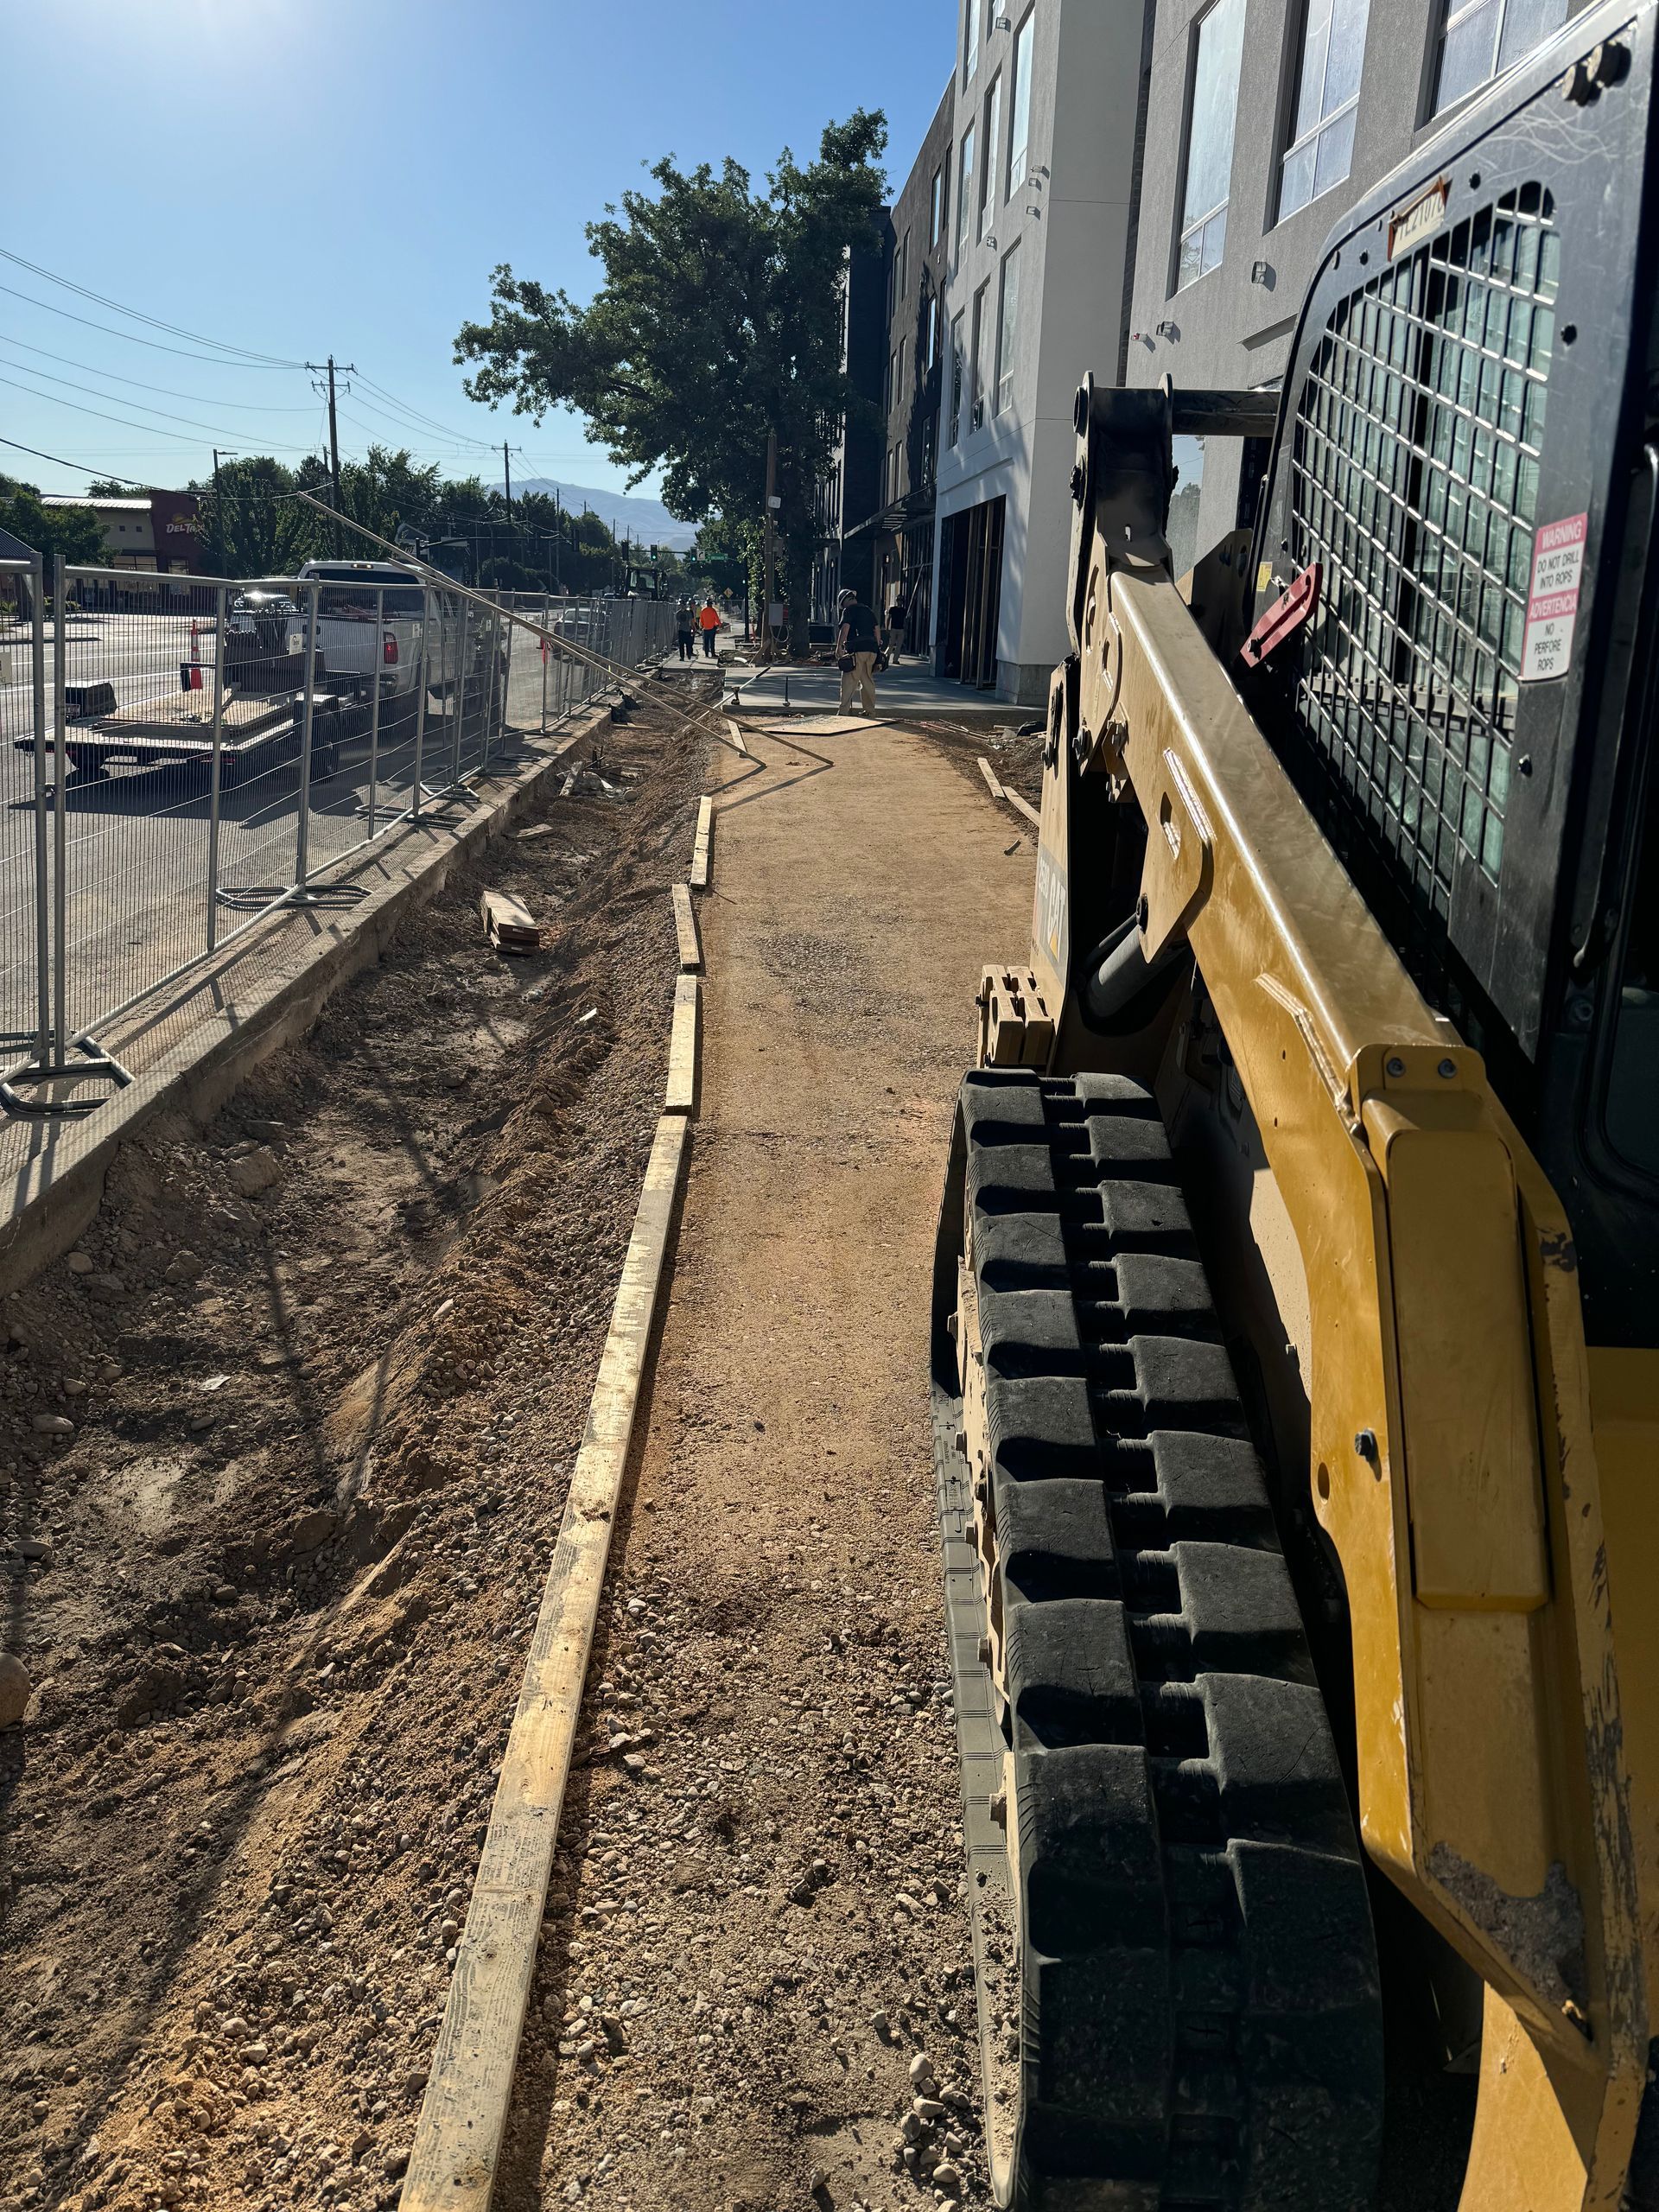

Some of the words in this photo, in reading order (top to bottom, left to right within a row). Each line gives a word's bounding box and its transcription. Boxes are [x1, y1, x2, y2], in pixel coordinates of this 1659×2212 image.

[1542, 521, 1581, 549] WARNING
[1537, 557, 1547, 574] DO
[1548, 553, 1560, 569] NOT
[1562, 550, 1580, 566] DRILL
[1540, 574, 1554, 590] INTO
[1555, 569, 1573, 587] ROPS
[1529, 594, 1577, 619] ADVERTENCIA
[1545, 622, 1554, 636] NO
[1535, 639, 1562, 655] PERFORE
[1537, 657, 1554, 672] ROPS
[1047, 873, 1065, 963] CAT
